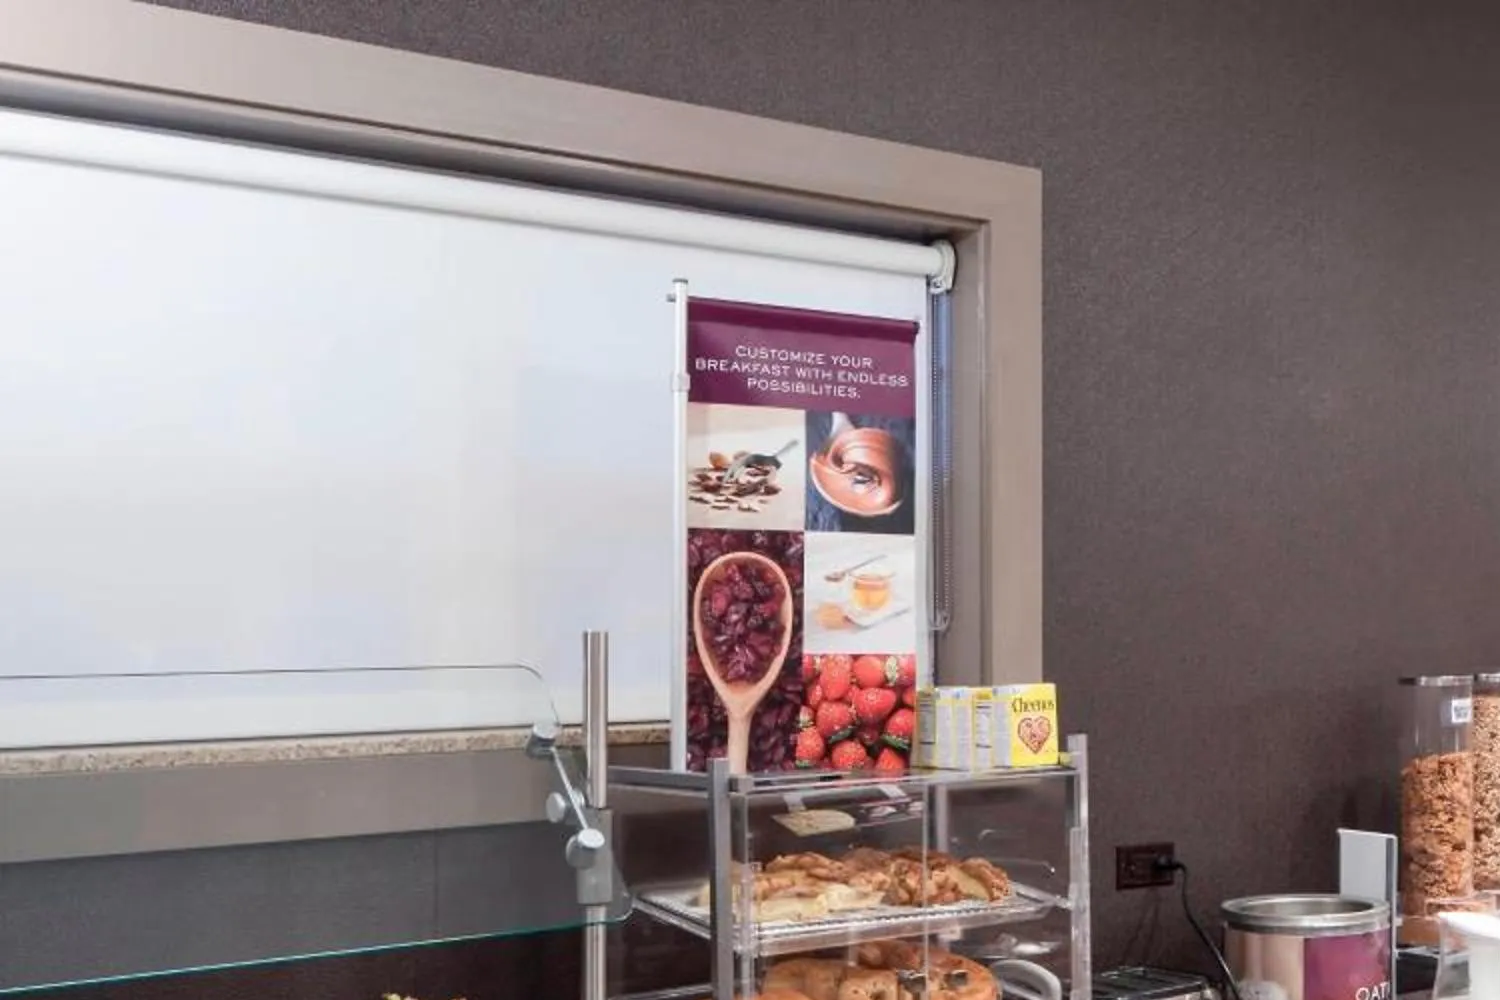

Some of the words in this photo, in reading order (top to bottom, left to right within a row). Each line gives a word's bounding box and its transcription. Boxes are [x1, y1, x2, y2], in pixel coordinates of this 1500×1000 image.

[735, 345, 826, 366] CUSTOMIZE
[831, 355, 873, 370] YOUR
[695, 357, 791, 377] BREAKFAST
[795, 366, 834, 381] WITH
[837, 370, 909, 388] ENDLESS
[747, 377, 861, 399] POSSIBILITIES.
